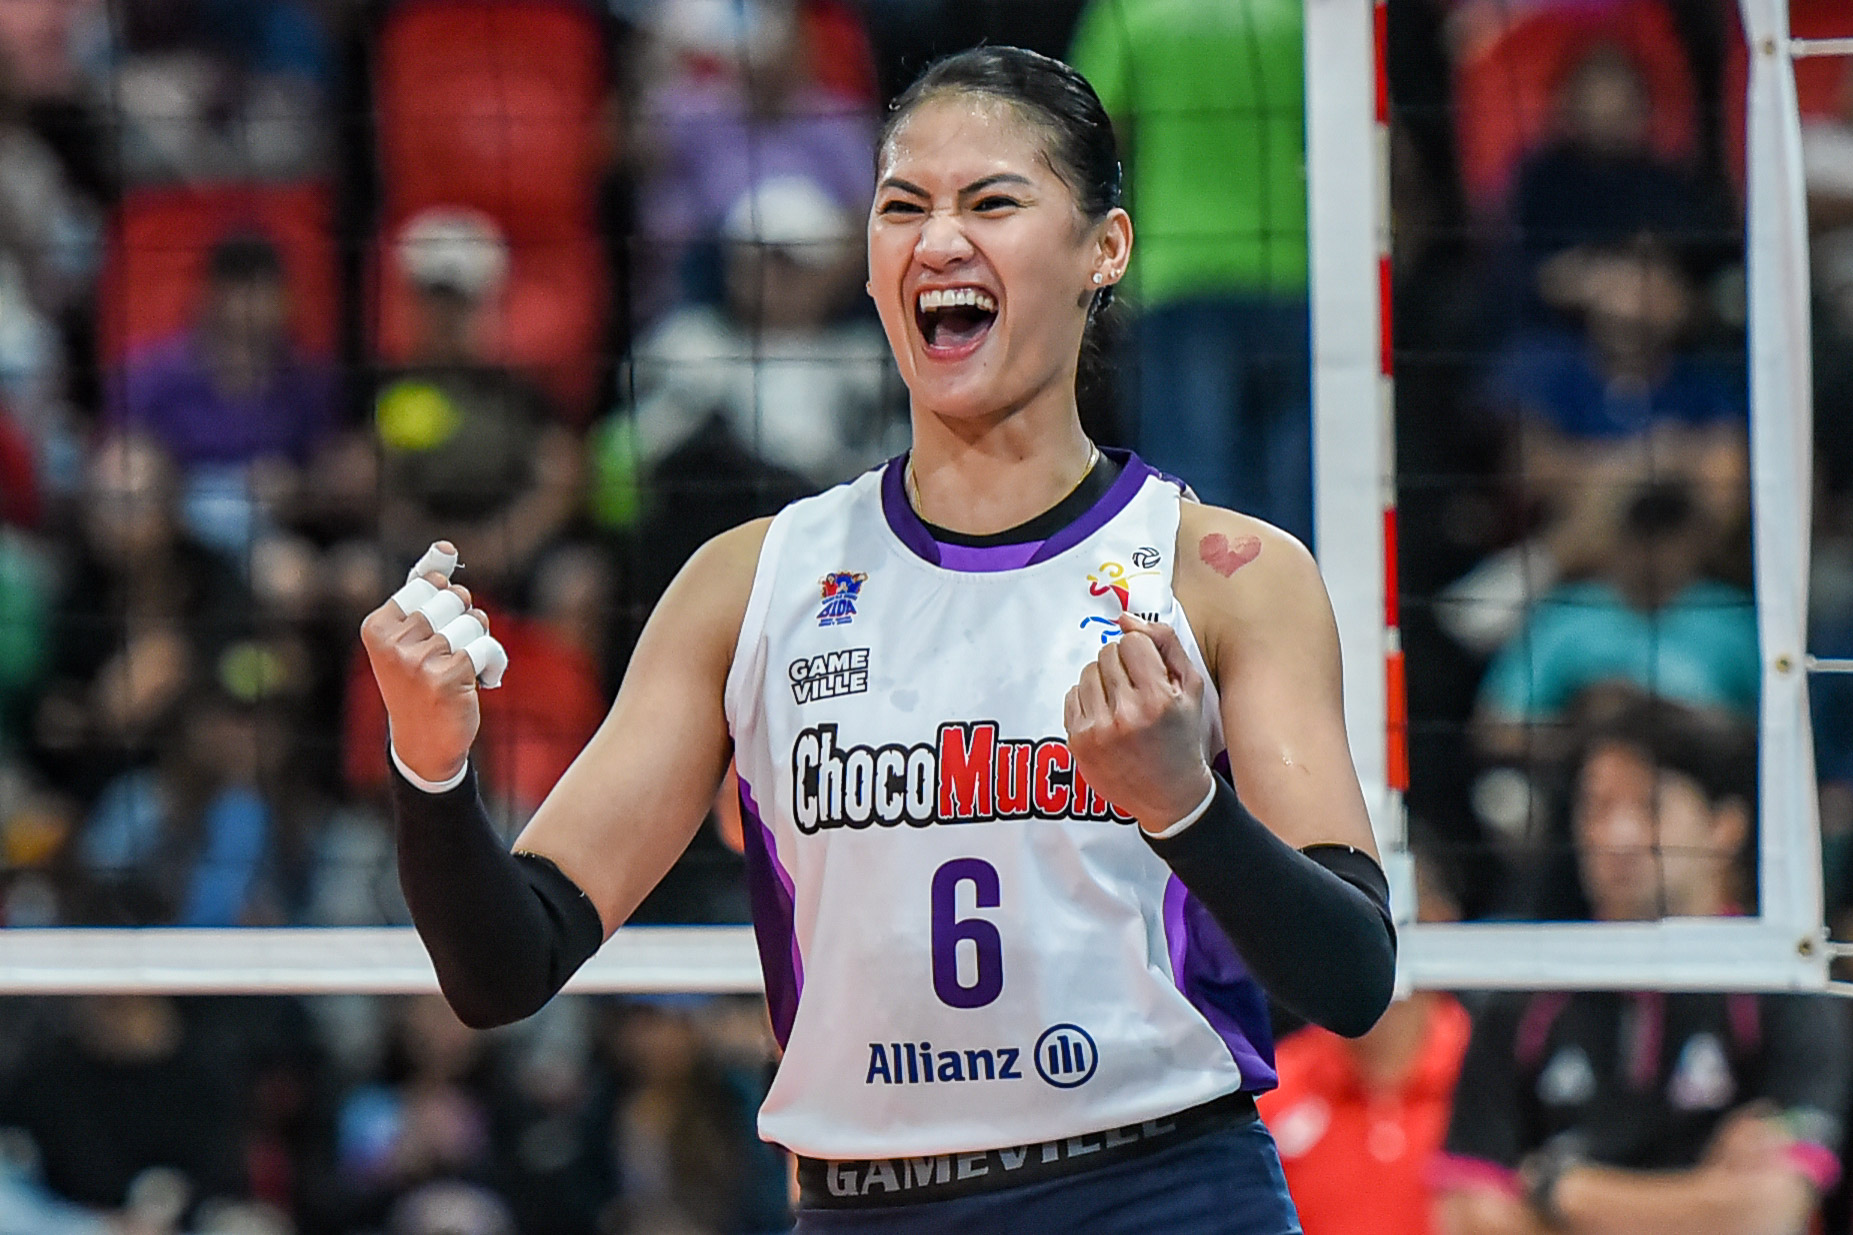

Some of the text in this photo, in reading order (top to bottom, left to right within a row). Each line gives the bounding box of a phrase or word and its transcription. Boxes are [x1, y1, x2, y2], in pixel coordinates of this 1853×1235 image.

[789, 648, 870, 682] GAME
[791, 670, 869, 705] VILLE
[793, 721, 1139, 835] ChocoMuc
[930, 857, 1004, 1009] 6
[865, 1041, 1022, 1085] Allianz
